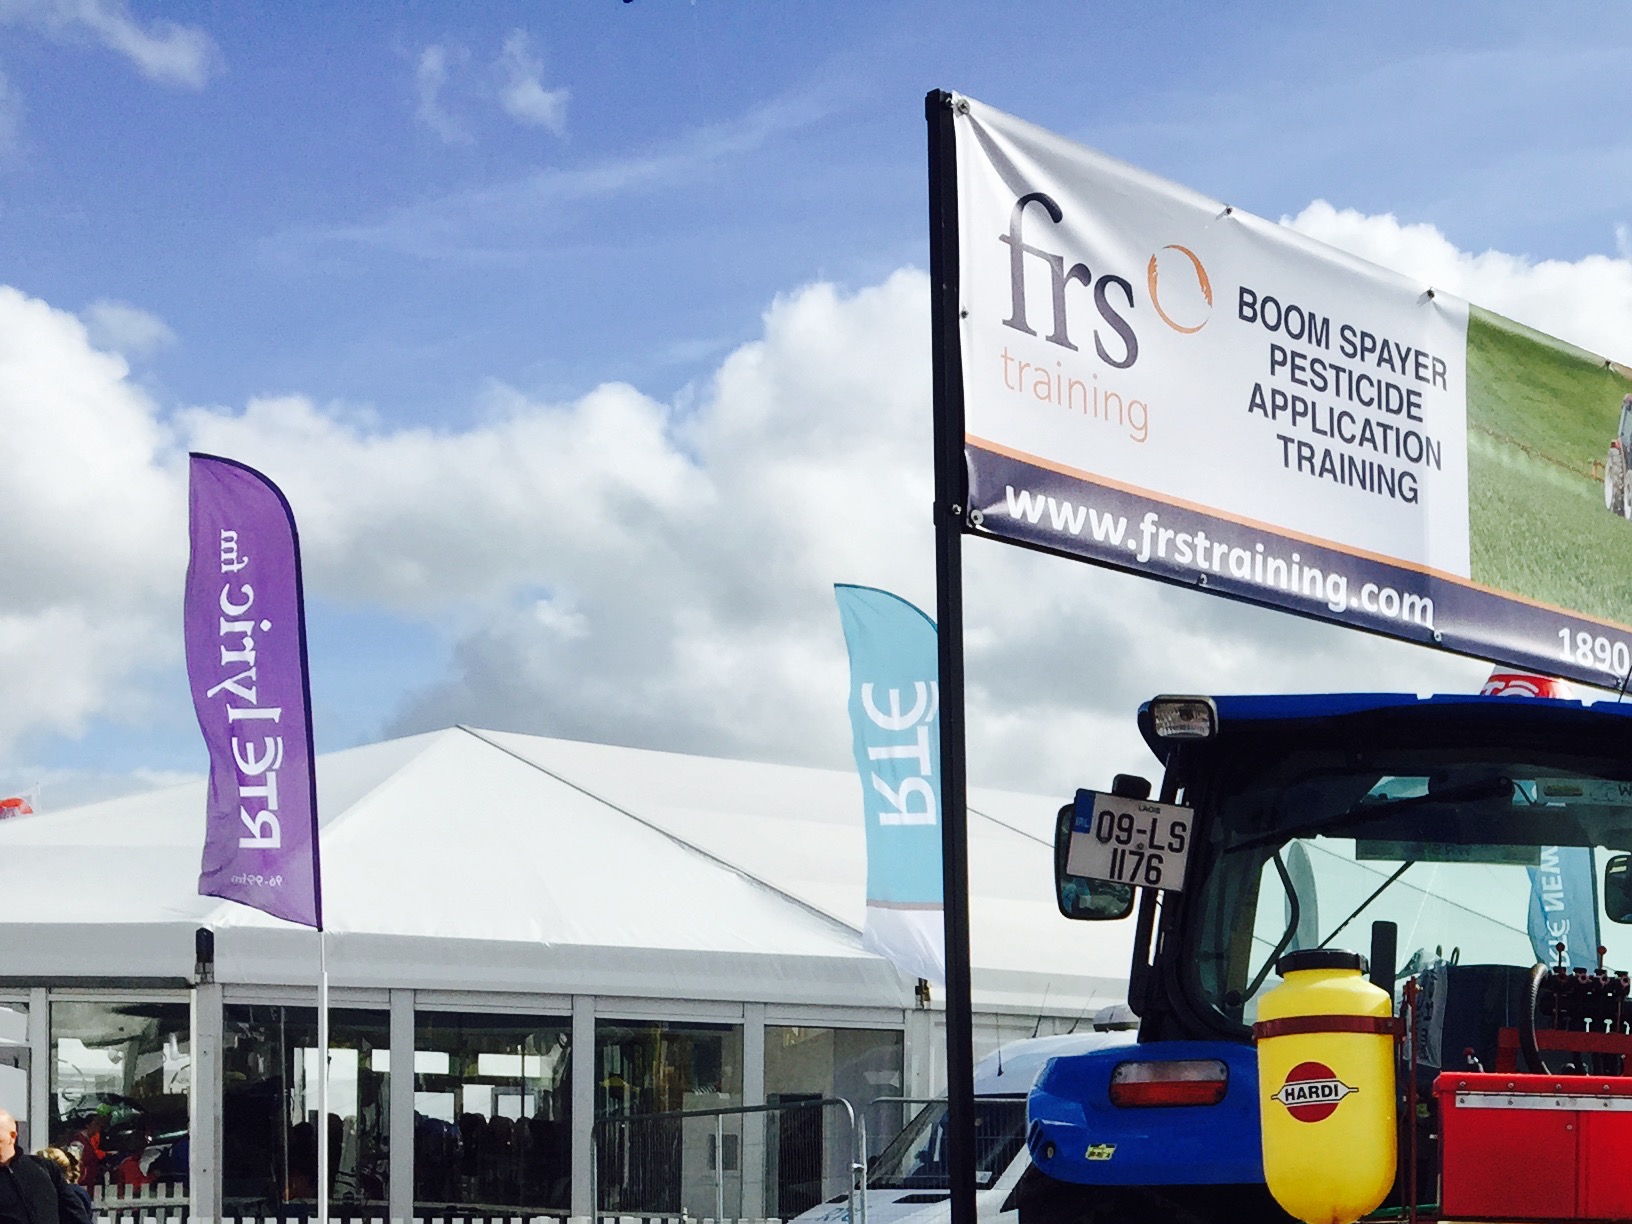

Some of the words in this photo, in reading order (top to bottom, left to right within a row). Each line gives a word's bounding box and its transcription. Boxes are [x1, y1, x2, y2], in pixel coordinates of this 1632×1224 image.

[999, 192, 1138, 369] frs
[1239, 286, 1330, 350] BOOM
[1340, 324, 1447, 391] SPAYER
[1001, 346, 1148, 442] training
[1270, 343, 1423, 423] PESTICIDE
[1248, 382, 1442, 471] APPLICATION
[1276, 433, 1418, 505] TRAINING
[1005, 485, 1435, 632] www.frstraining.com
[1558, 627, 1630, 677] 1890
[1096, 810, 1187, 853] 09-LS
[1109, 848, 1164, 885] 1176
[1284, 1084, 1340, 1102] HARDI
